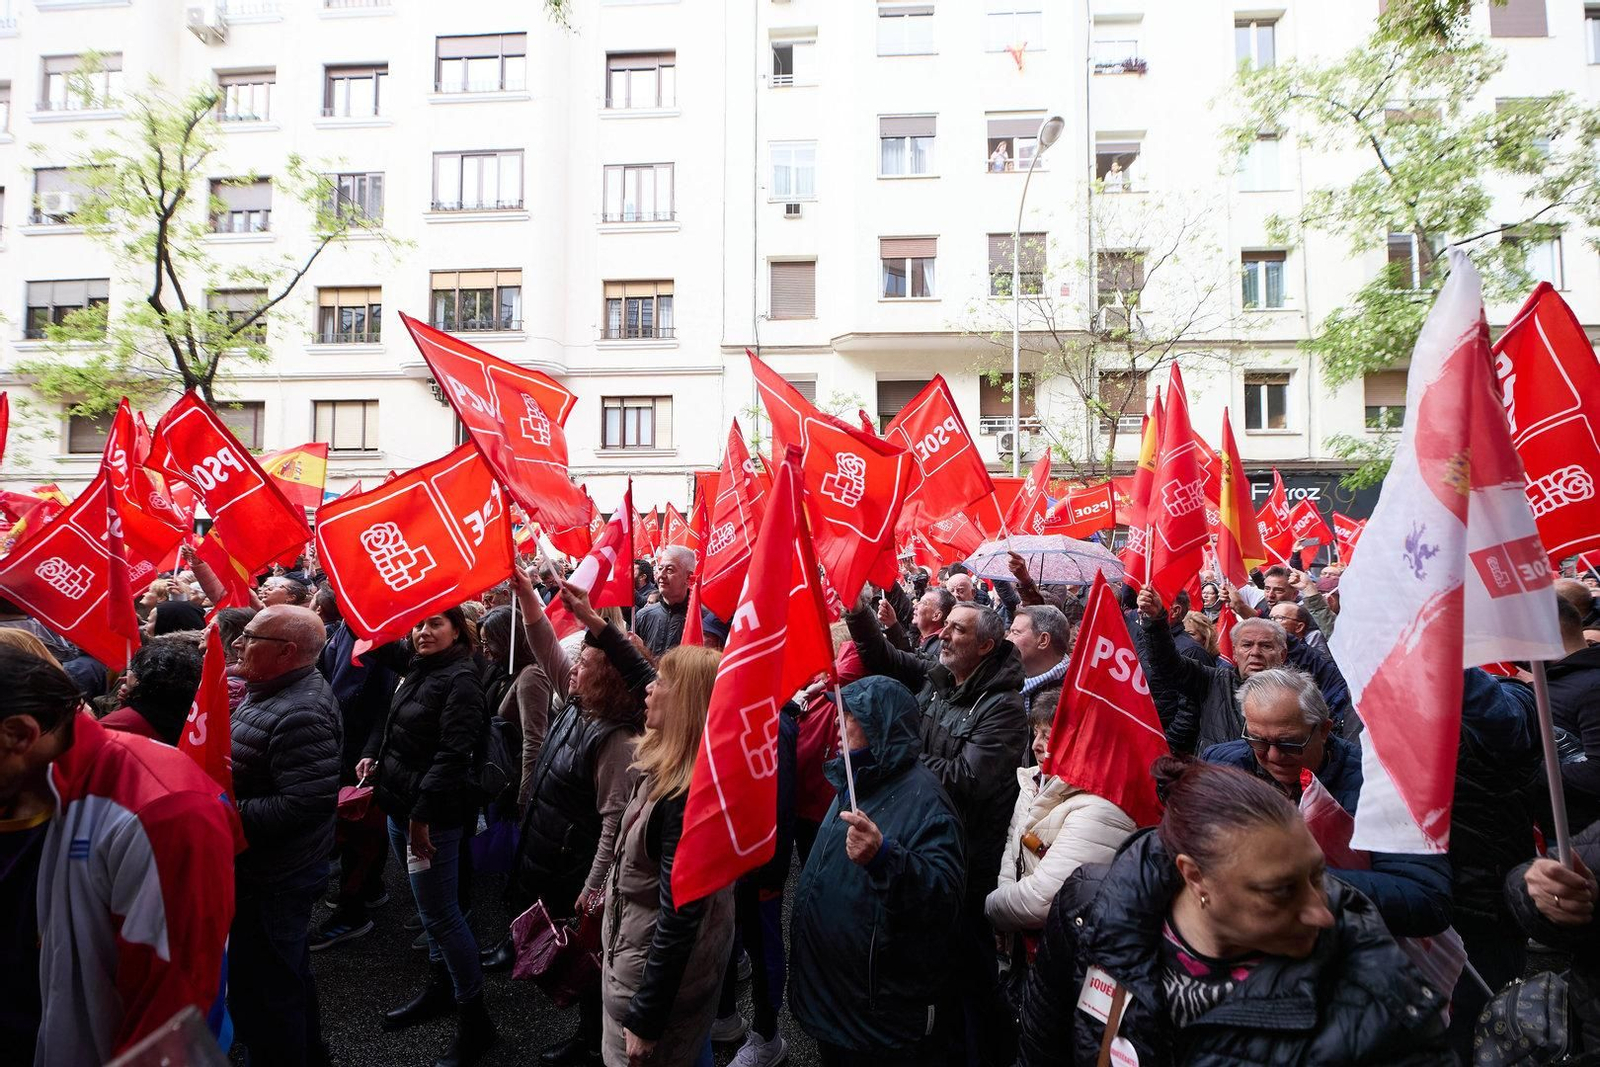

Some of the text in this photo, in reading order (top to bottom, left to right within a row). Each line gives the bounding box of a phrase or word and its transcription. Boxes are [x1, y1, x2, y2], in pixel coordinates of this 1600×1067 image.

[445, 374, 497, 418] PSO
[1251, 483, 1321, 500] Froz
[1090, 634, 1150, 695] PSO
